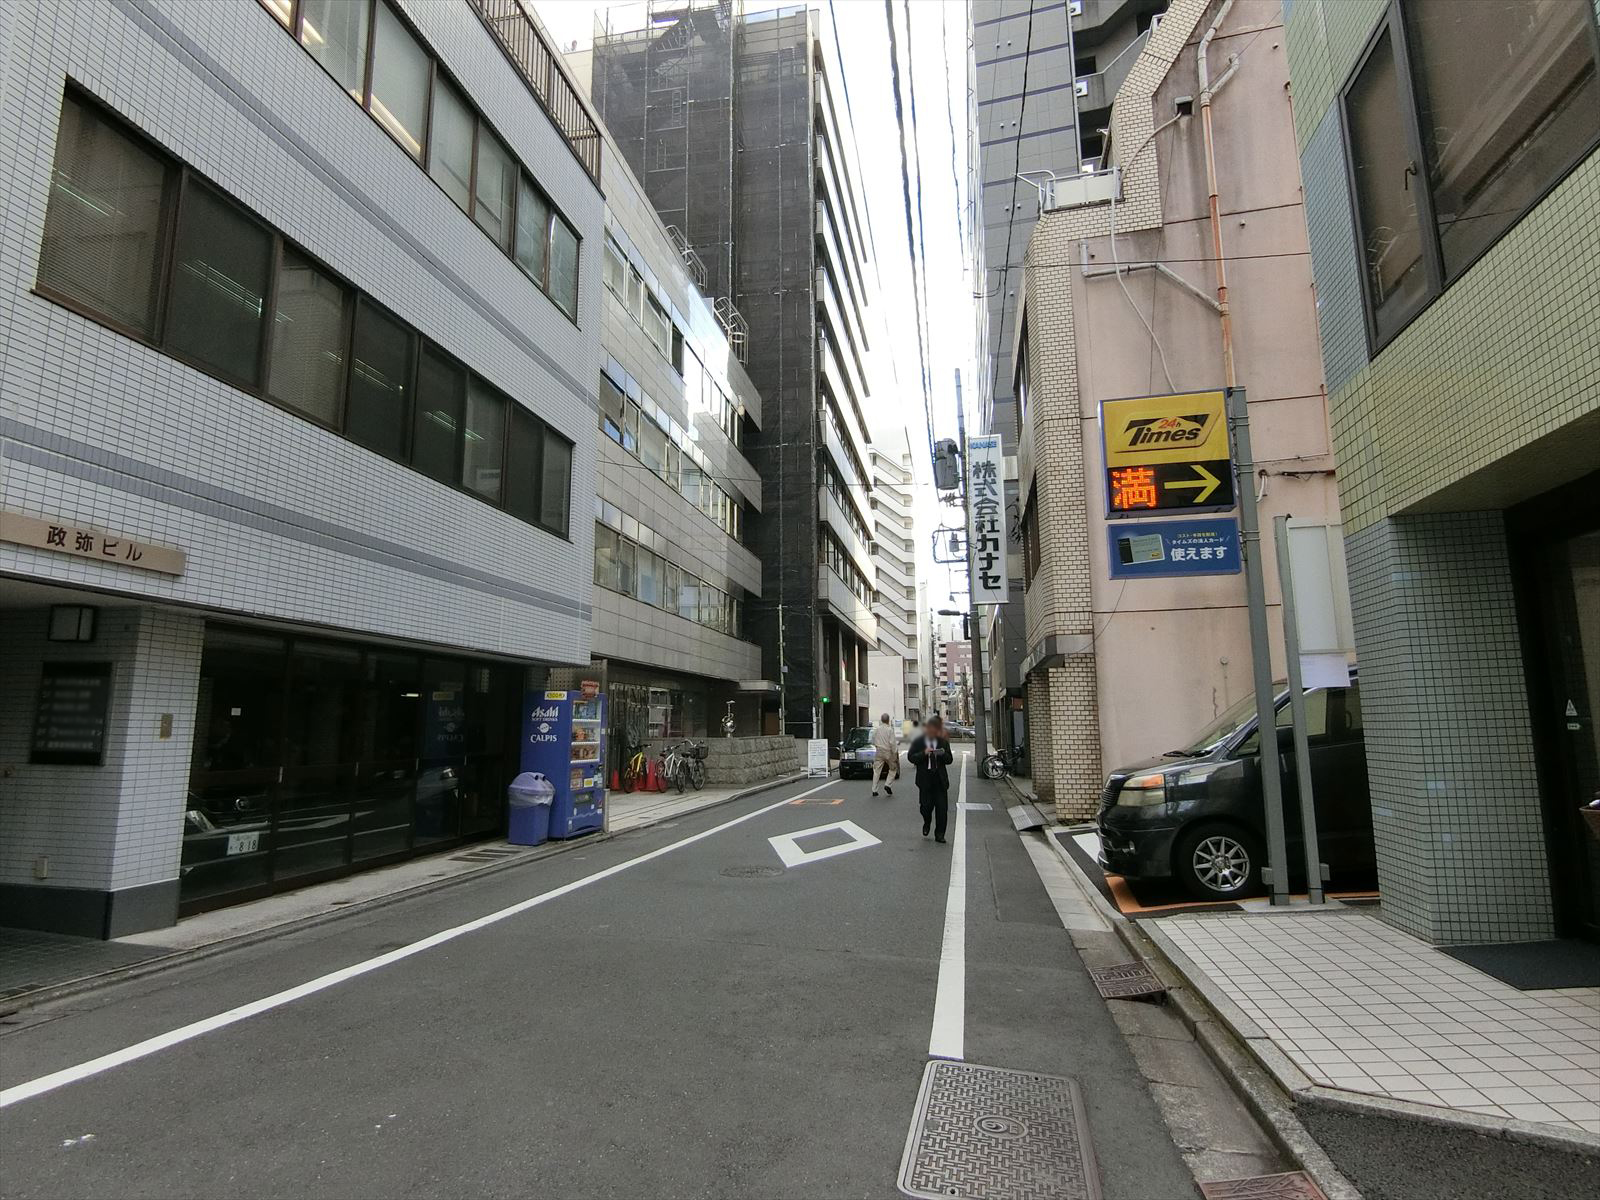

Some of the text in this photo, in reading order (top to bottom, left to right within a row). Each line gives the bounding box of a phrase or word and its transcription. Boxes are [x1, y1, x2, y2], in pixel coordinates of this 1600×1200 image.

[1124, 416, 1206, 446] Times
[1112, 467, 1156, 508] 満
[972, 460, 1001, 590] 株式会社カナセ
[47, 526, 142, 562] 政弥ビル
[1170, 545, 1228, 561] 使えます
[531, 706, 559, 718] Asahi
[530, 734, 558, 743] CALPIS
